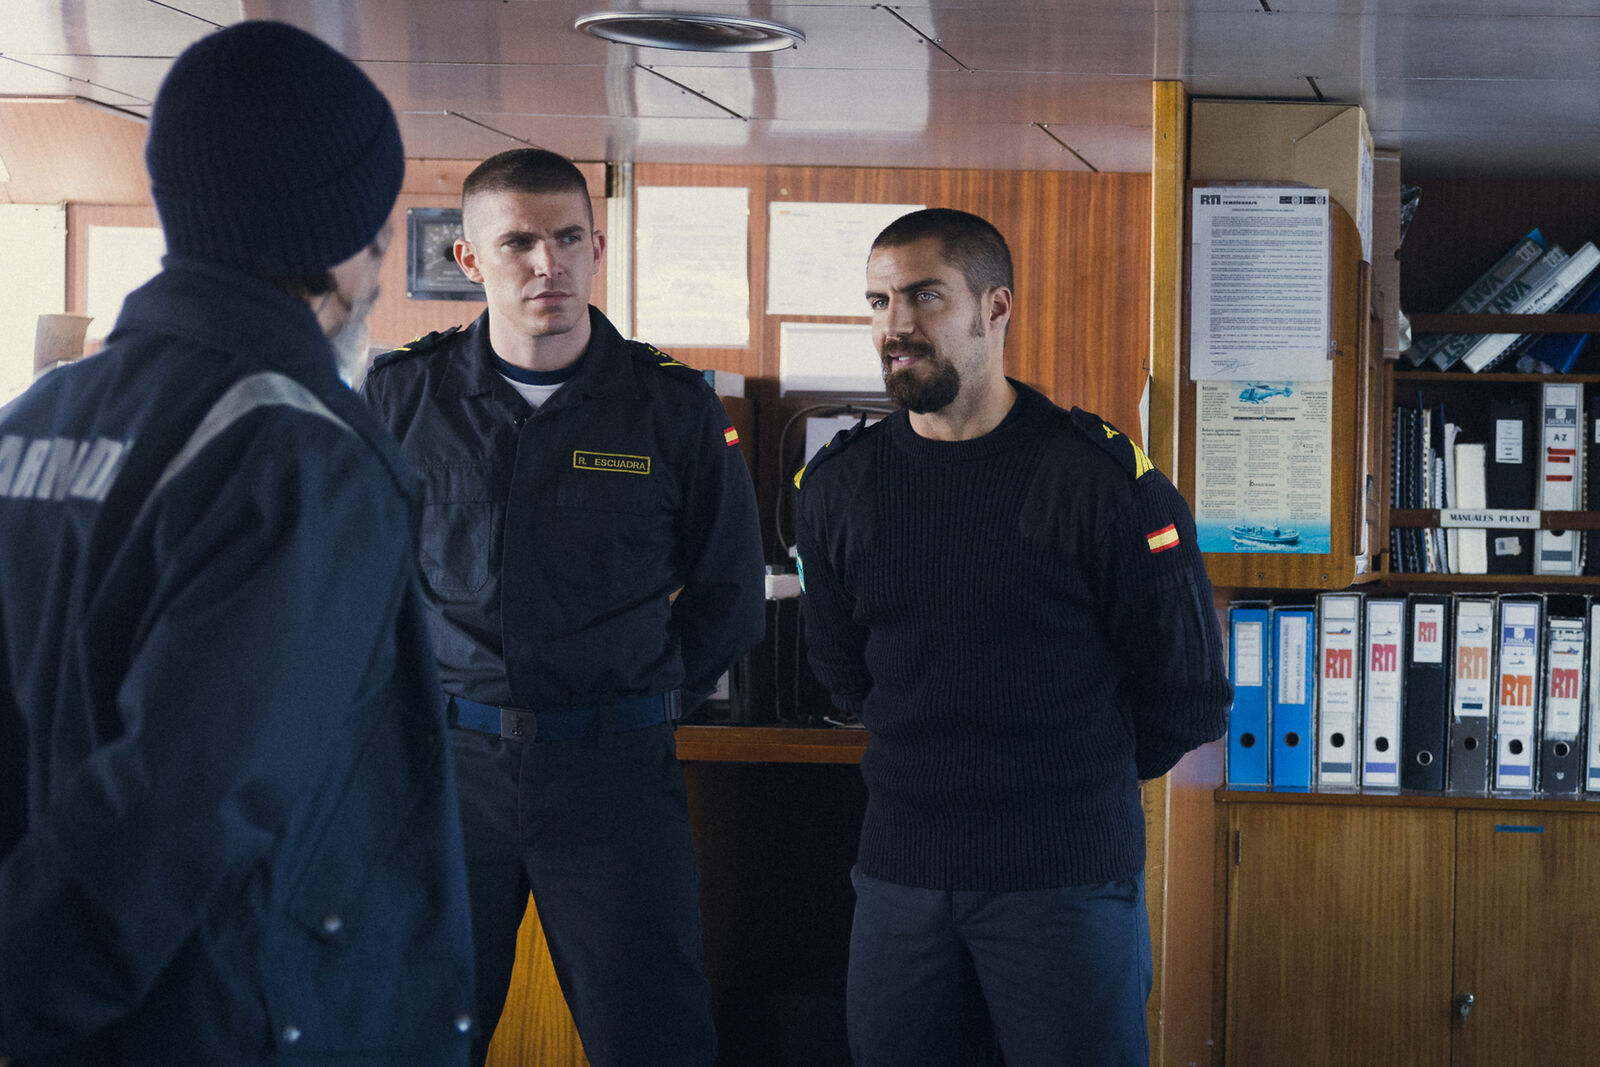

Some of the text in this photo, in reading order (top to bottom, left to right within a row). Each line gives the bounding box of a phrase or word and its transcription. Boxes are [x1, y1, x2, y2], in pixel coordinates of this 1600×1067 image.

[1494, 280, 1533, 314] VAN
[578, 456, 646, 470] R. ESCUADRA
[1450, 513, 1530, 523] MANUALES PUENTE
